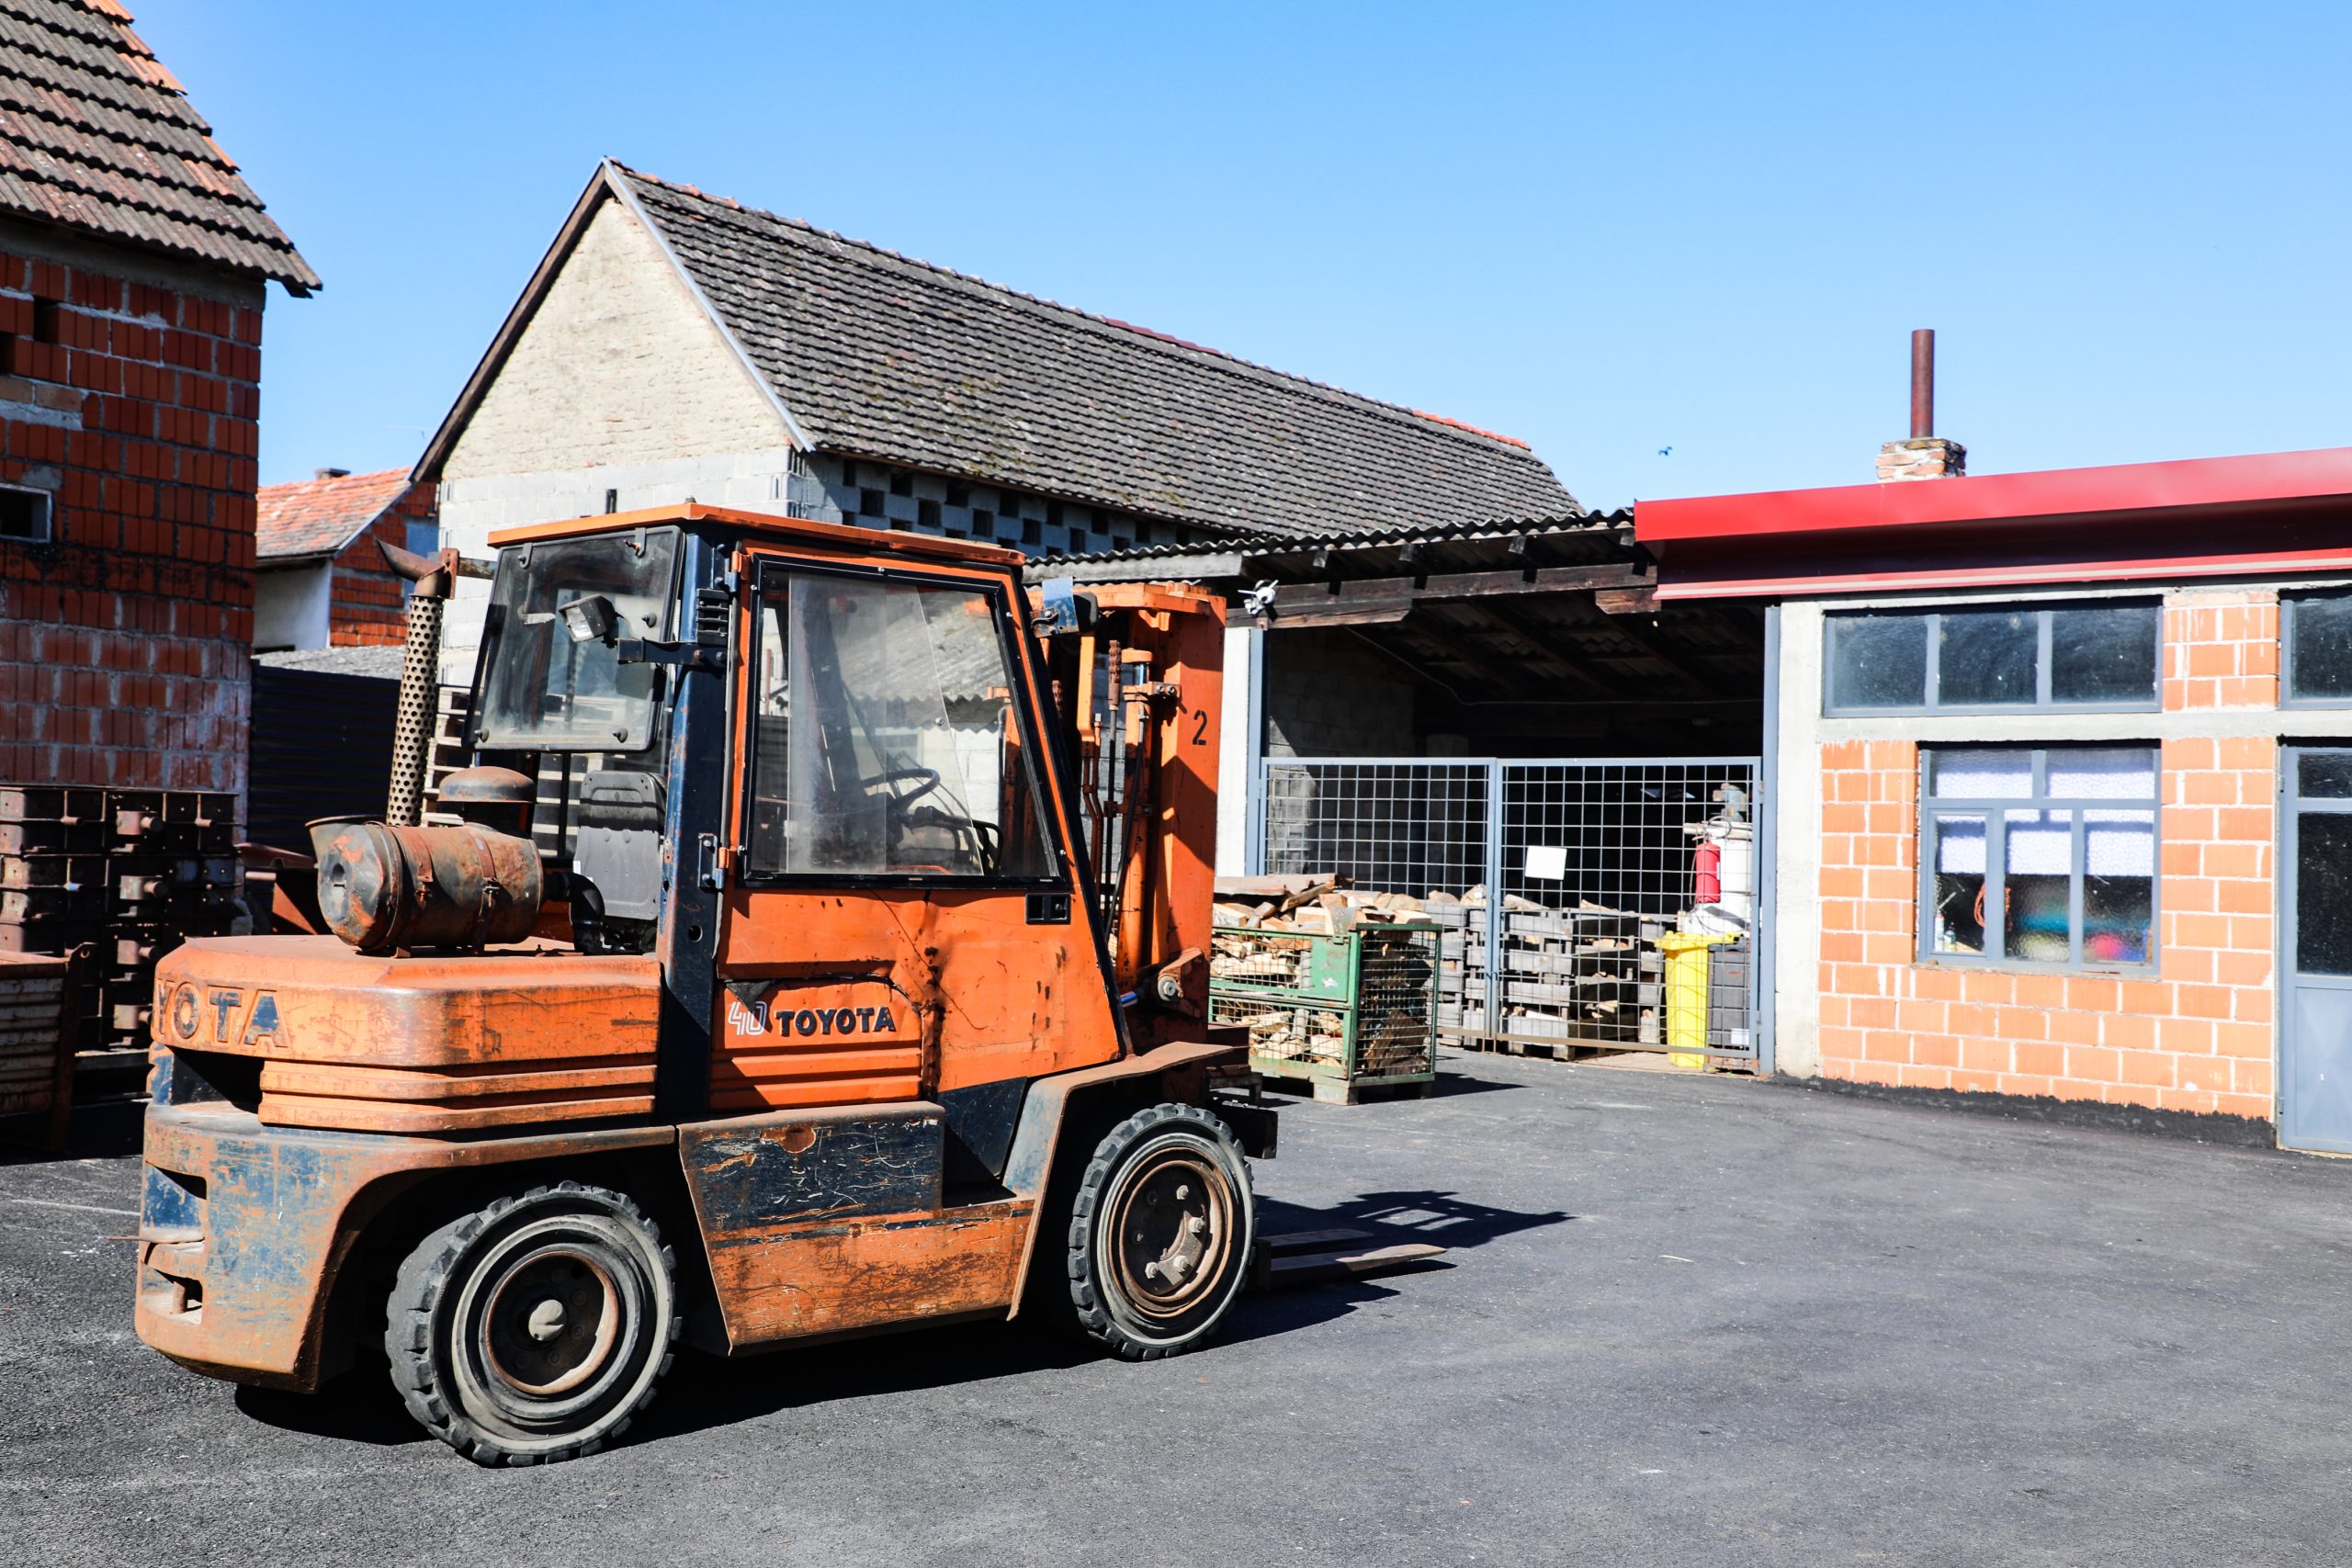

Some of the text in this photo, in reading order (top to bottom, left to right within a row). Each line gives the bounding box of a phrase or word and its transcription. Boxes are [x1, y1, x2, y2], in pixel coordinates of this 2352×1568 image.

[1193, 709, 1208, 746] 2
[728, 1001, 897, 1037] 40 TOYOTA
